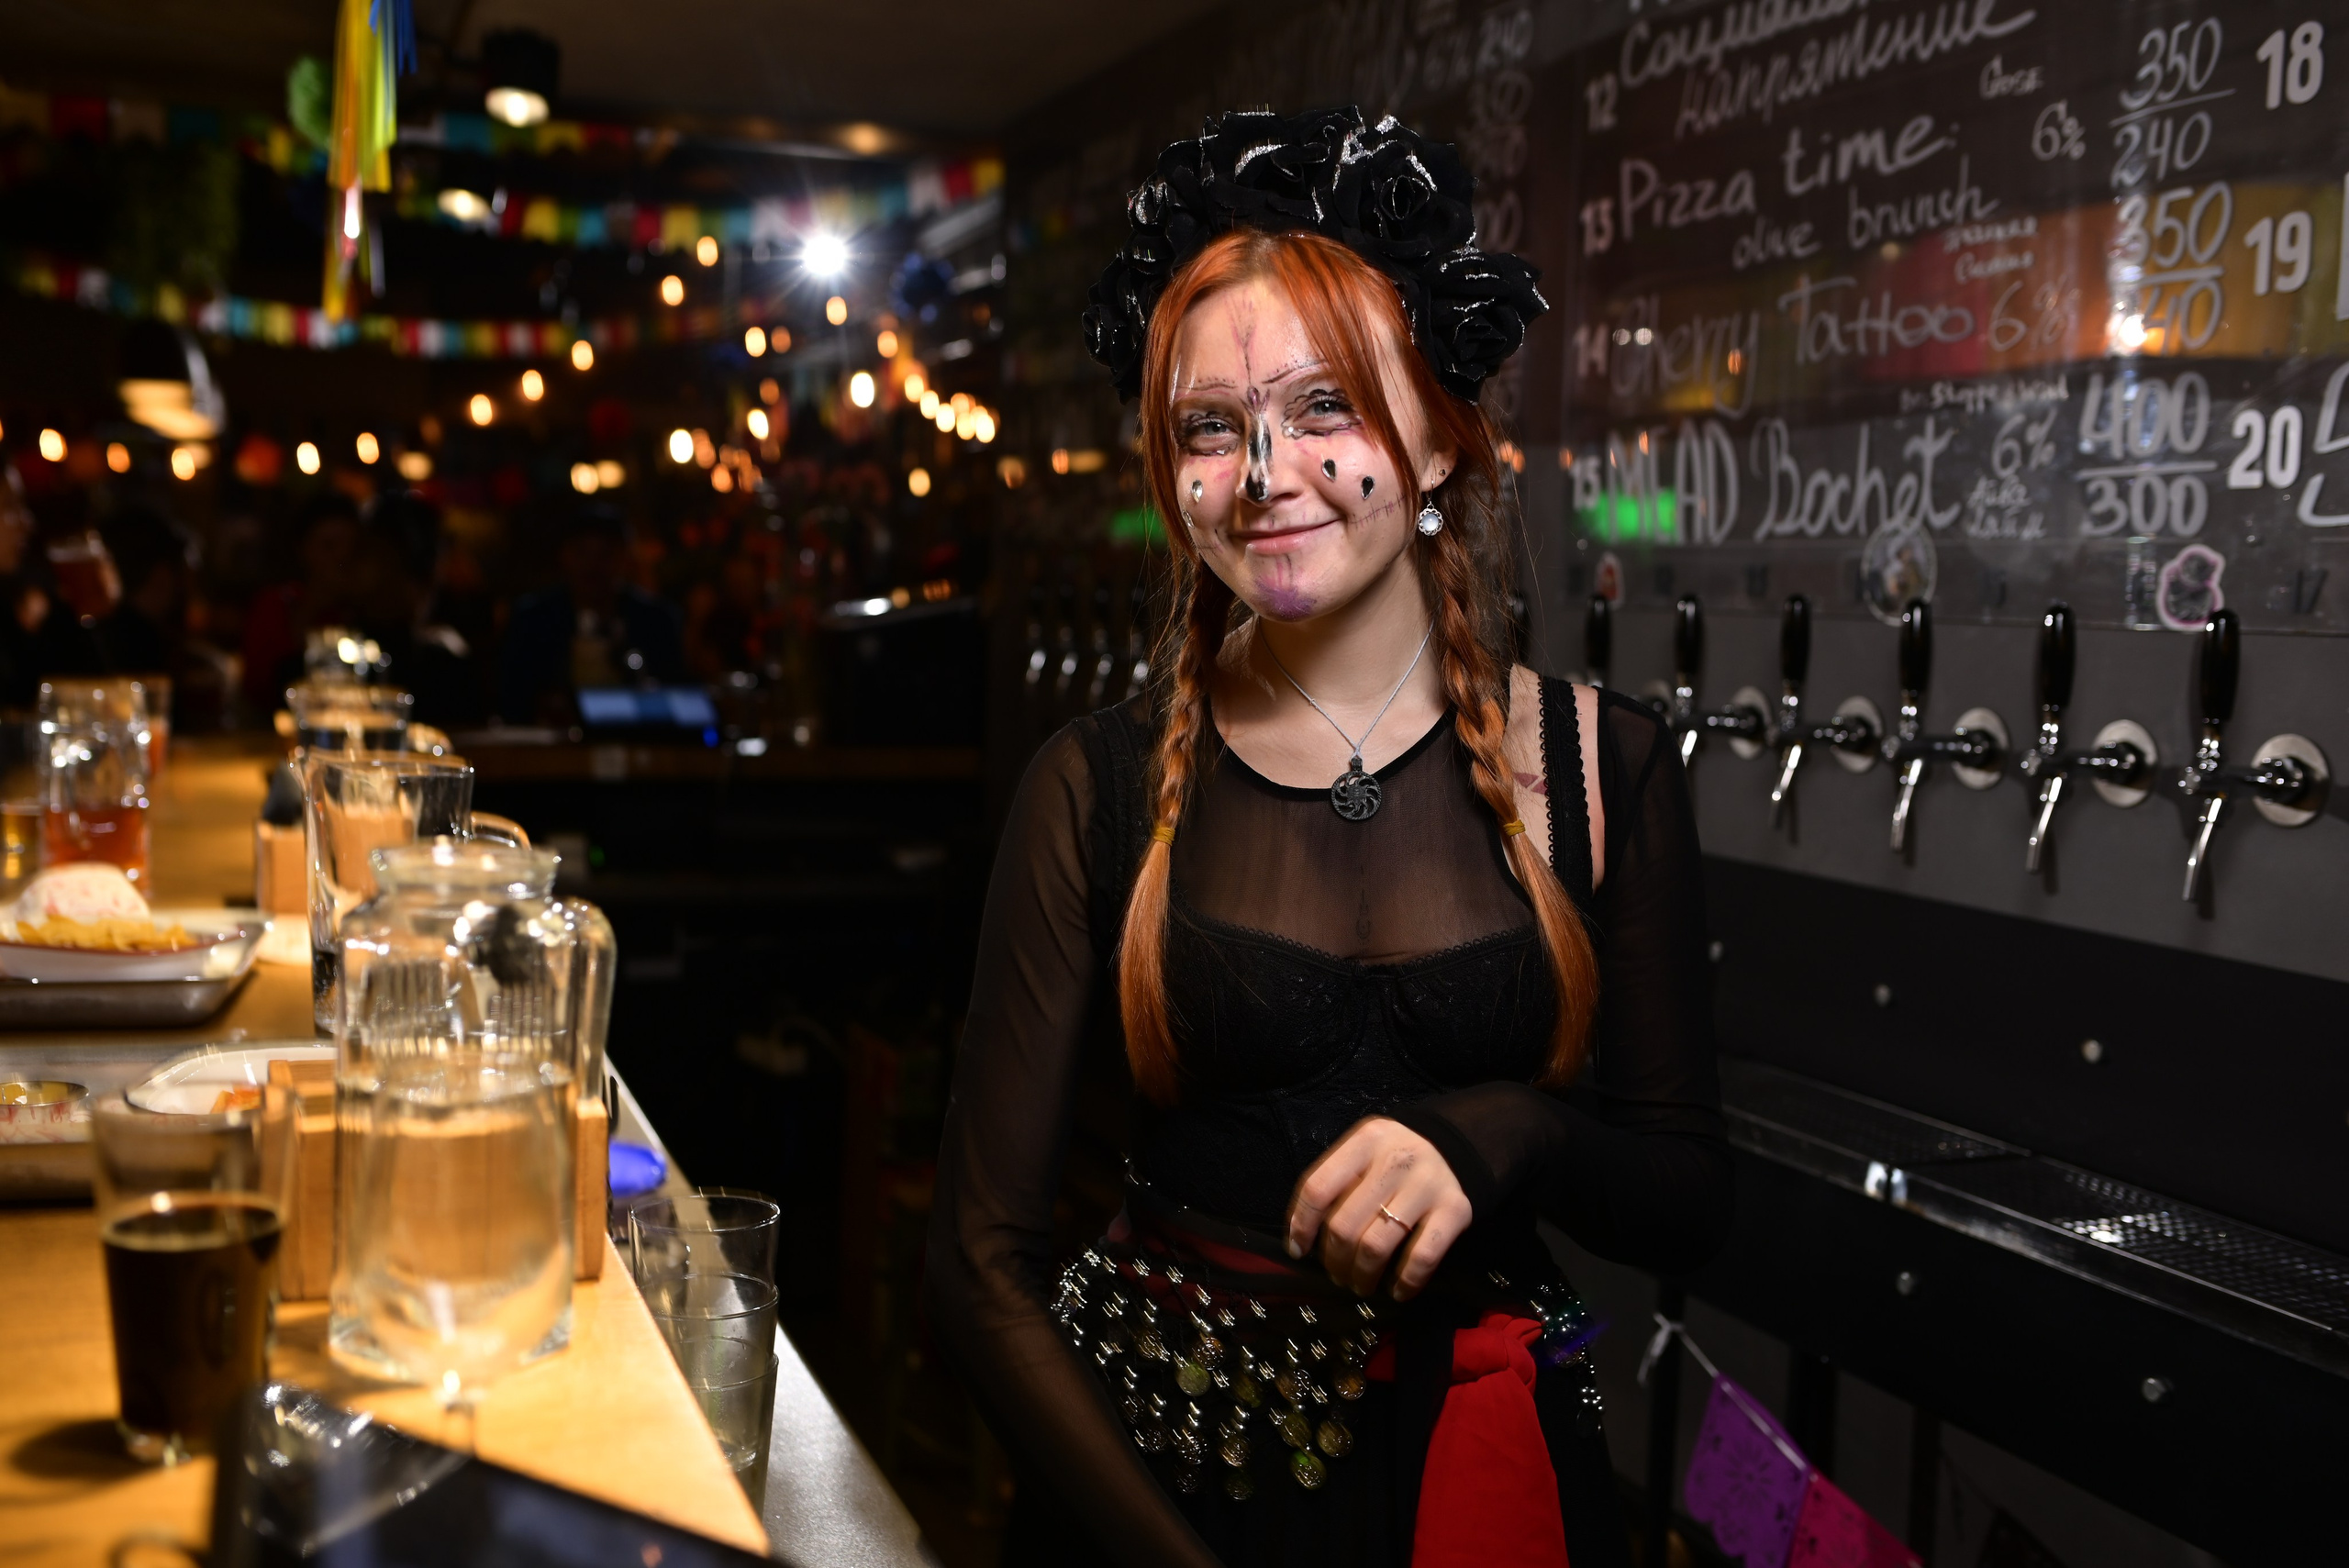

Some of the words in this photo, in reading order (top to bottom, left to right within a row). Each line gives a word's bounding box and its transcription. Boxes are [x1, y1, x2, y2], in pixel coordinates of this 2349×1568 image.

[1585, 71, 1619, 133] 12
[2120, 17, 2223, 111] 350
[2255, 20, 2324, 110] 18
[2031, 98, 2087, 161] 6%
[2111, 111, 2213, 187] 240
[1579, 195, 1616, 258] 13
[1620, 157, 1759, 241] Pizza
[1847, 153, 2001, 250] brunch
[2118, 181, 2232, 269] 350
[2243, 210, 2312, 296] 19
[1608, 292, 1760, 420] Cherry
[1777, 276, 1975, 365] Tattoo
[2077, 372, 2210, 459] 400
[2227, 405, 2303, 490] 20
[1749, 416, 1962, 546] Bochet
[1990, 408, 2059, 476] 6%
[2081, 474, 2209, 539] 300
